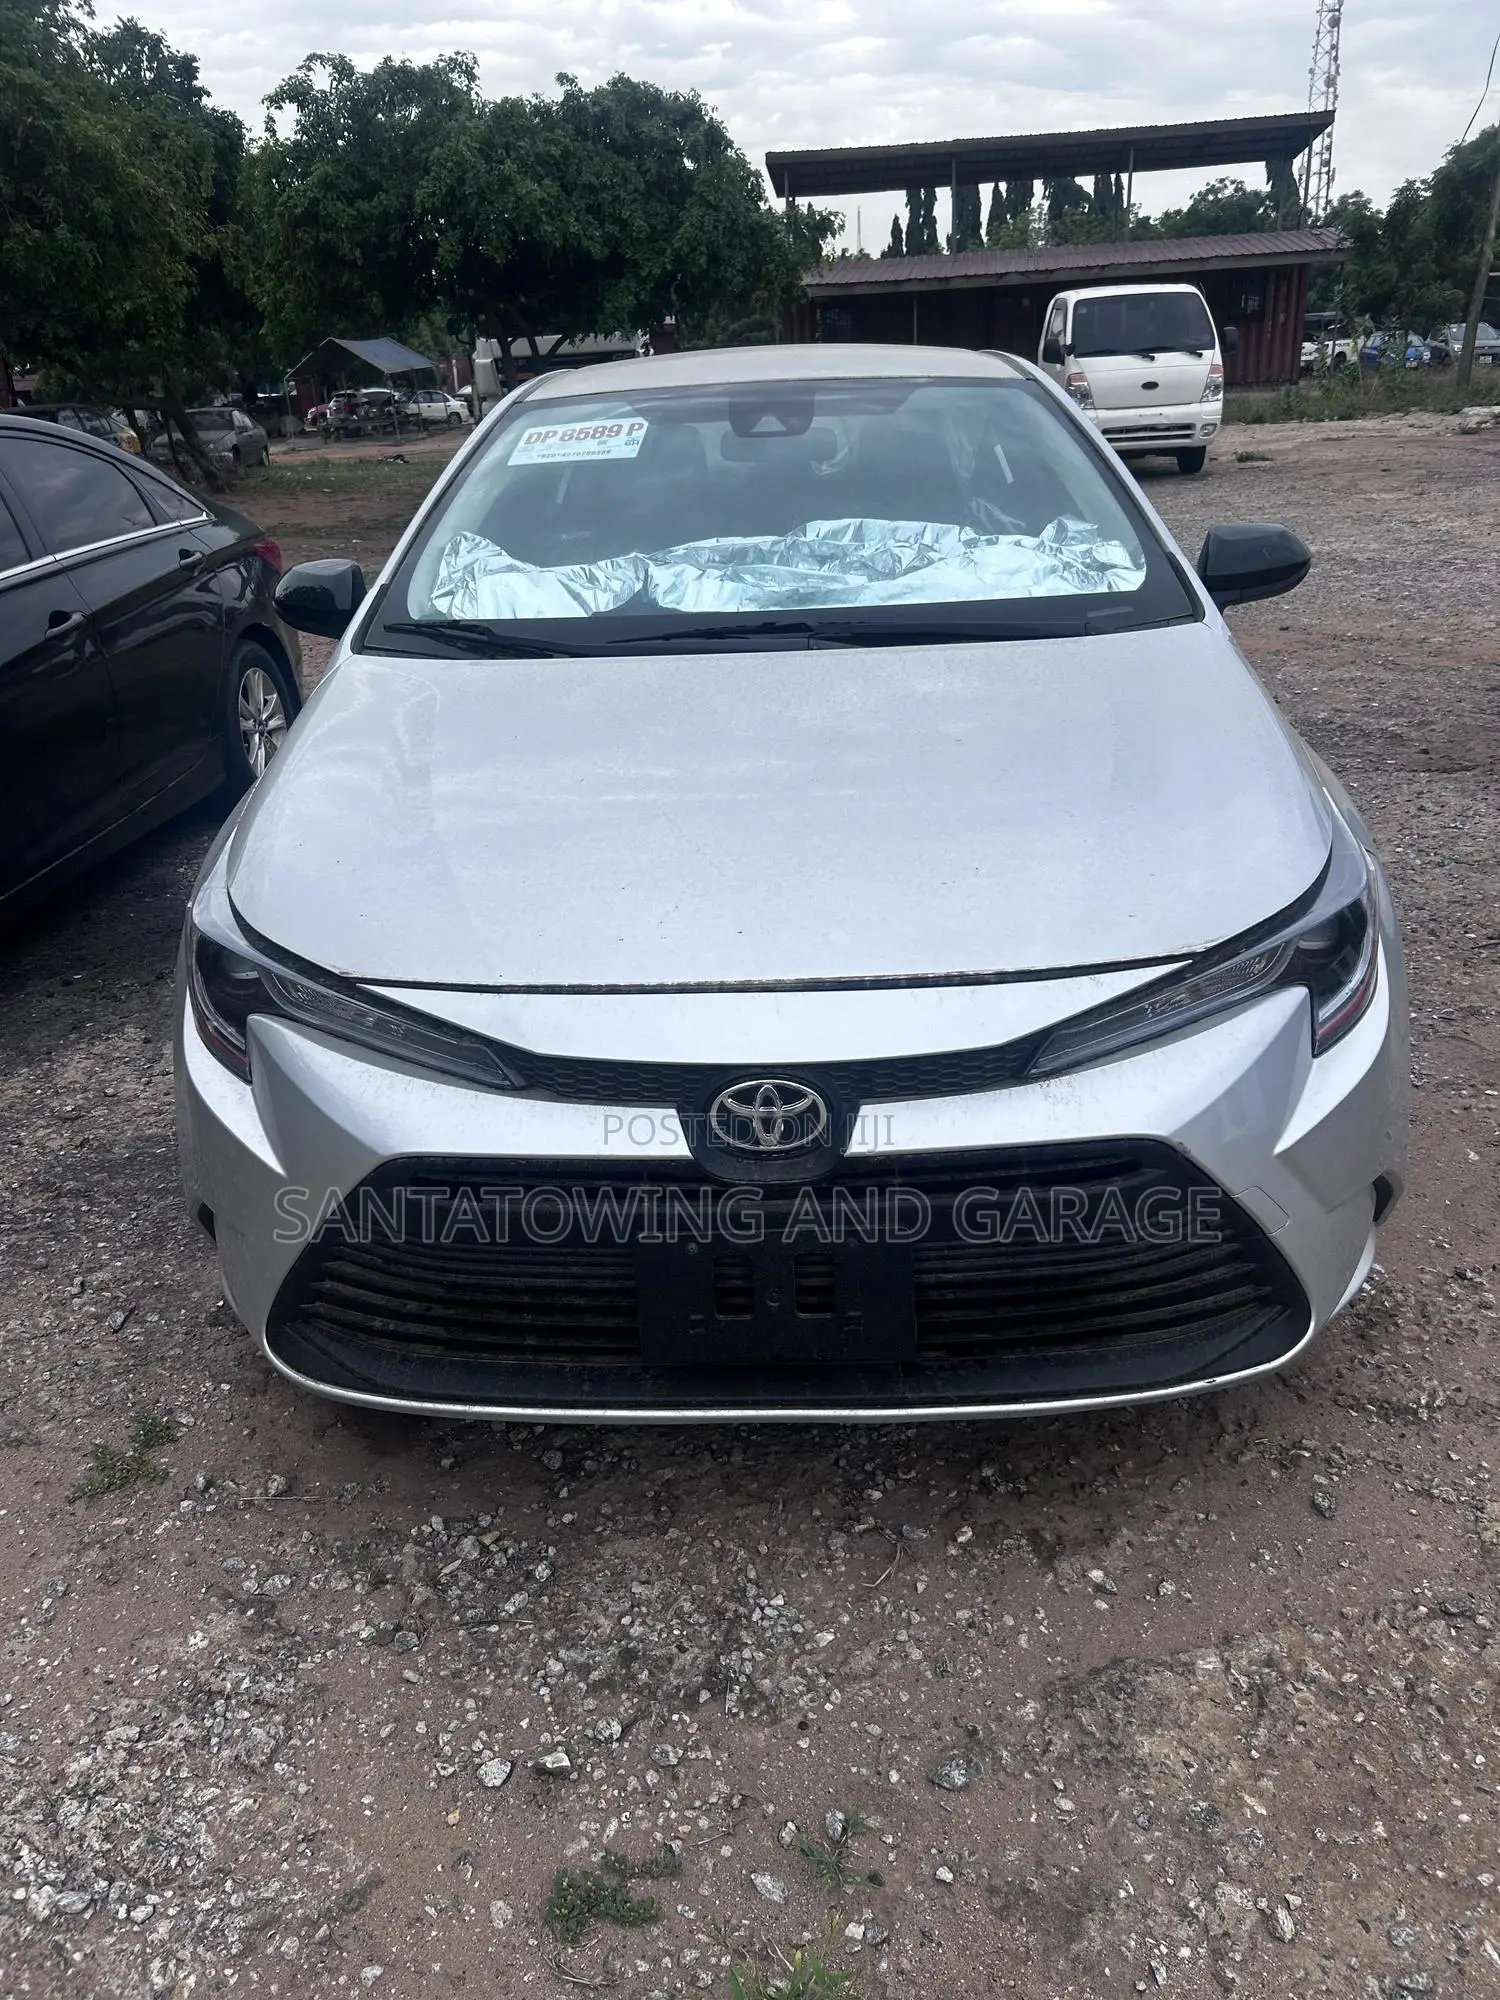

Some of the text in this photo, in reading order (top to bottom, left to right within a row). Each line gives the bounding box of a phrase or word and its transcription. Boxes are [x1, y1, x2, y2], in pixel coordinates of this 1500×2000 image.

[524, 422, 644, 445] DP 8589 P
